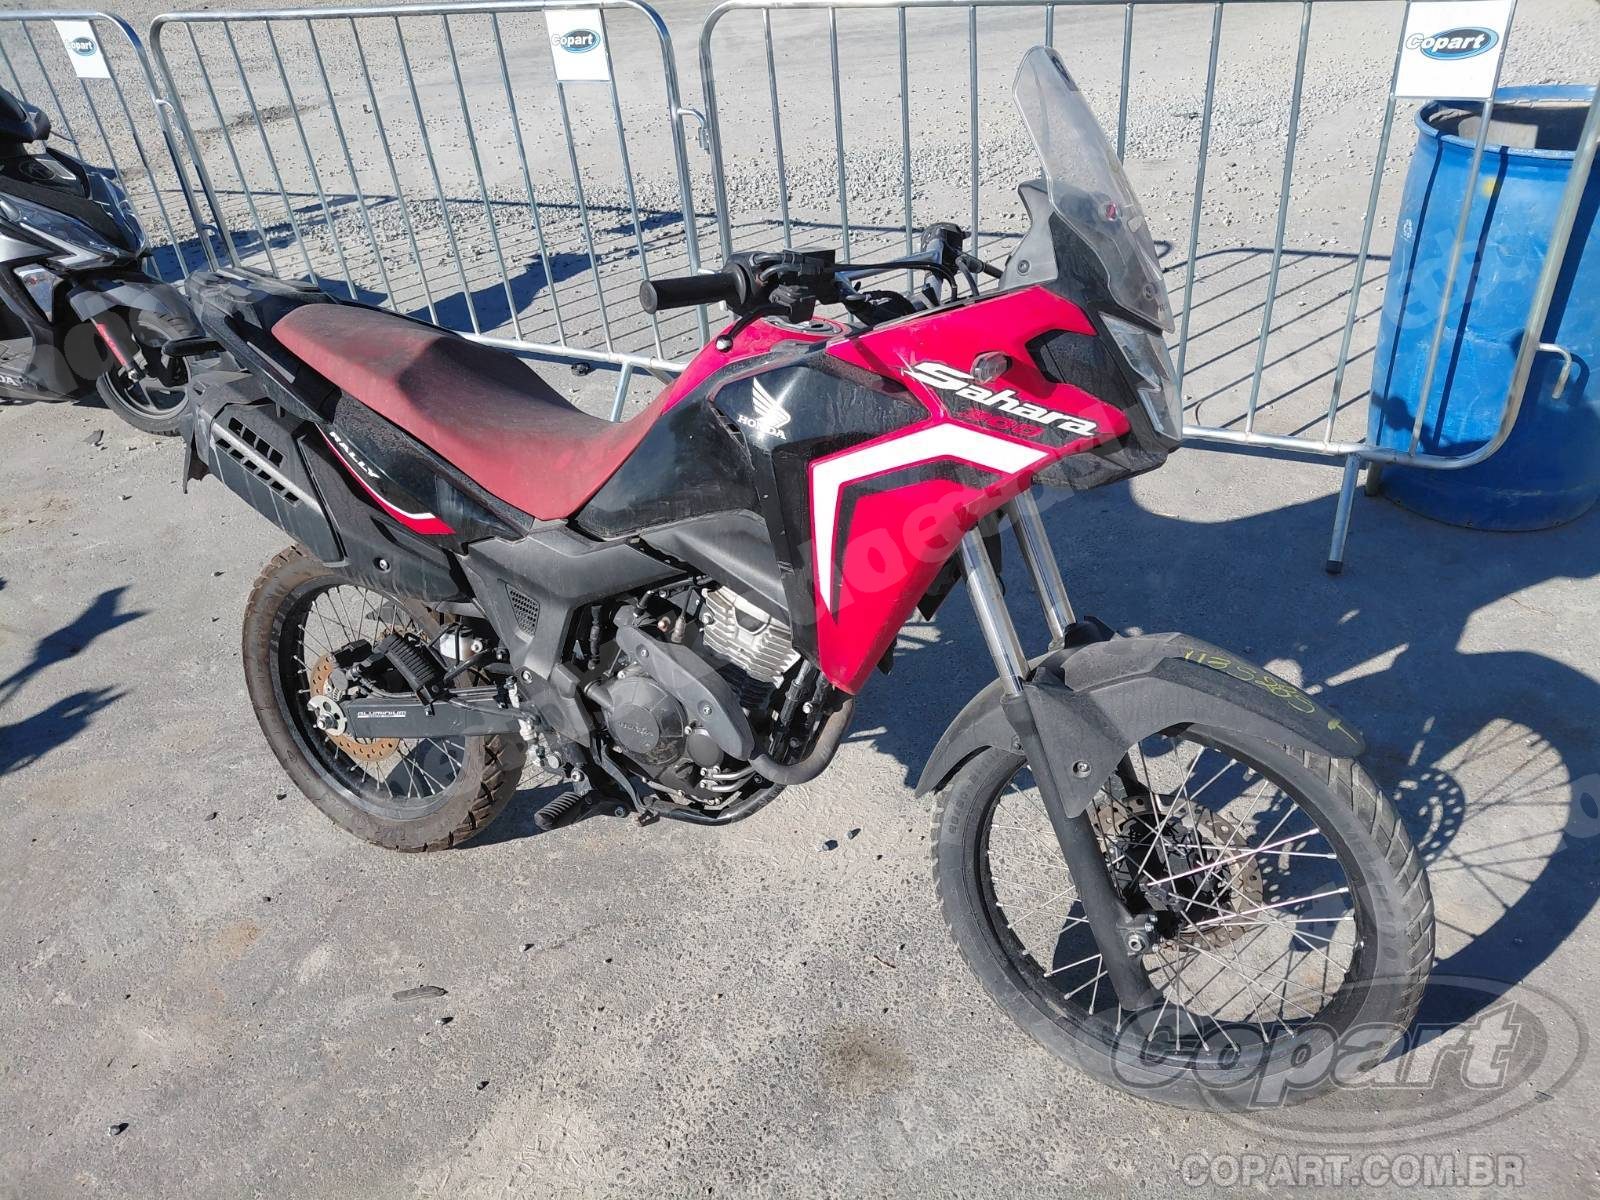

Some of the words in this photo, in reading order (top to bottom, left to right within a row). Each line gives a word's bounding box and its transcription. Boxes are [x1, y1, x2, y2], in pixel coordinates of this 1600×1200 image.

[551, 33, 594, 47] Copart
[1406, 32, 1486, 53] Copart
[903, 361, 1098, 436] Sahara
